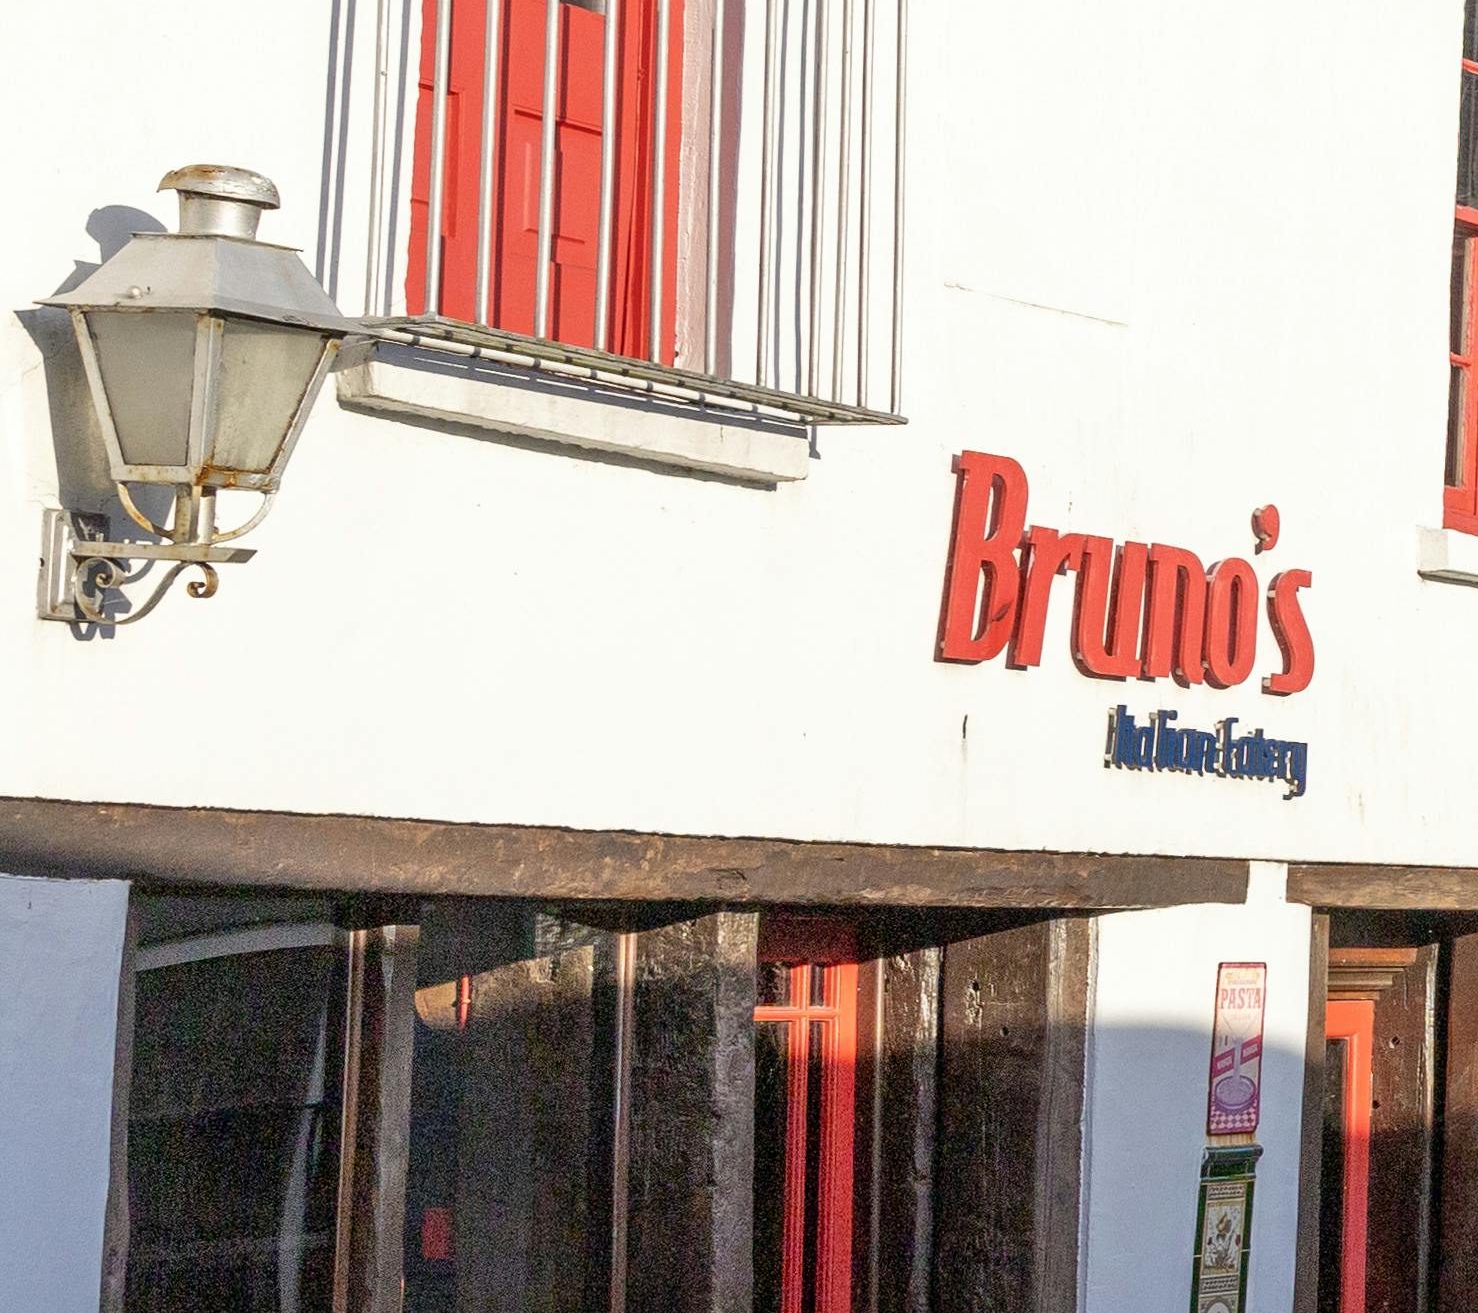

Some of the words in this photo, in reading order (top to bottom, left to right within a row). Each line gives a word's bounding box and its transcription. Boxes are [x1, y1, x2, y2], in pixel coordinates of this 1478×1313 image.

[936, 450, 1315, 696] Bruno's
[1106, 704, 1217, 774] Italian
[1216, 717, 1308, 800] Eatery
[1220, 988, 1261, 1009] PASTA
